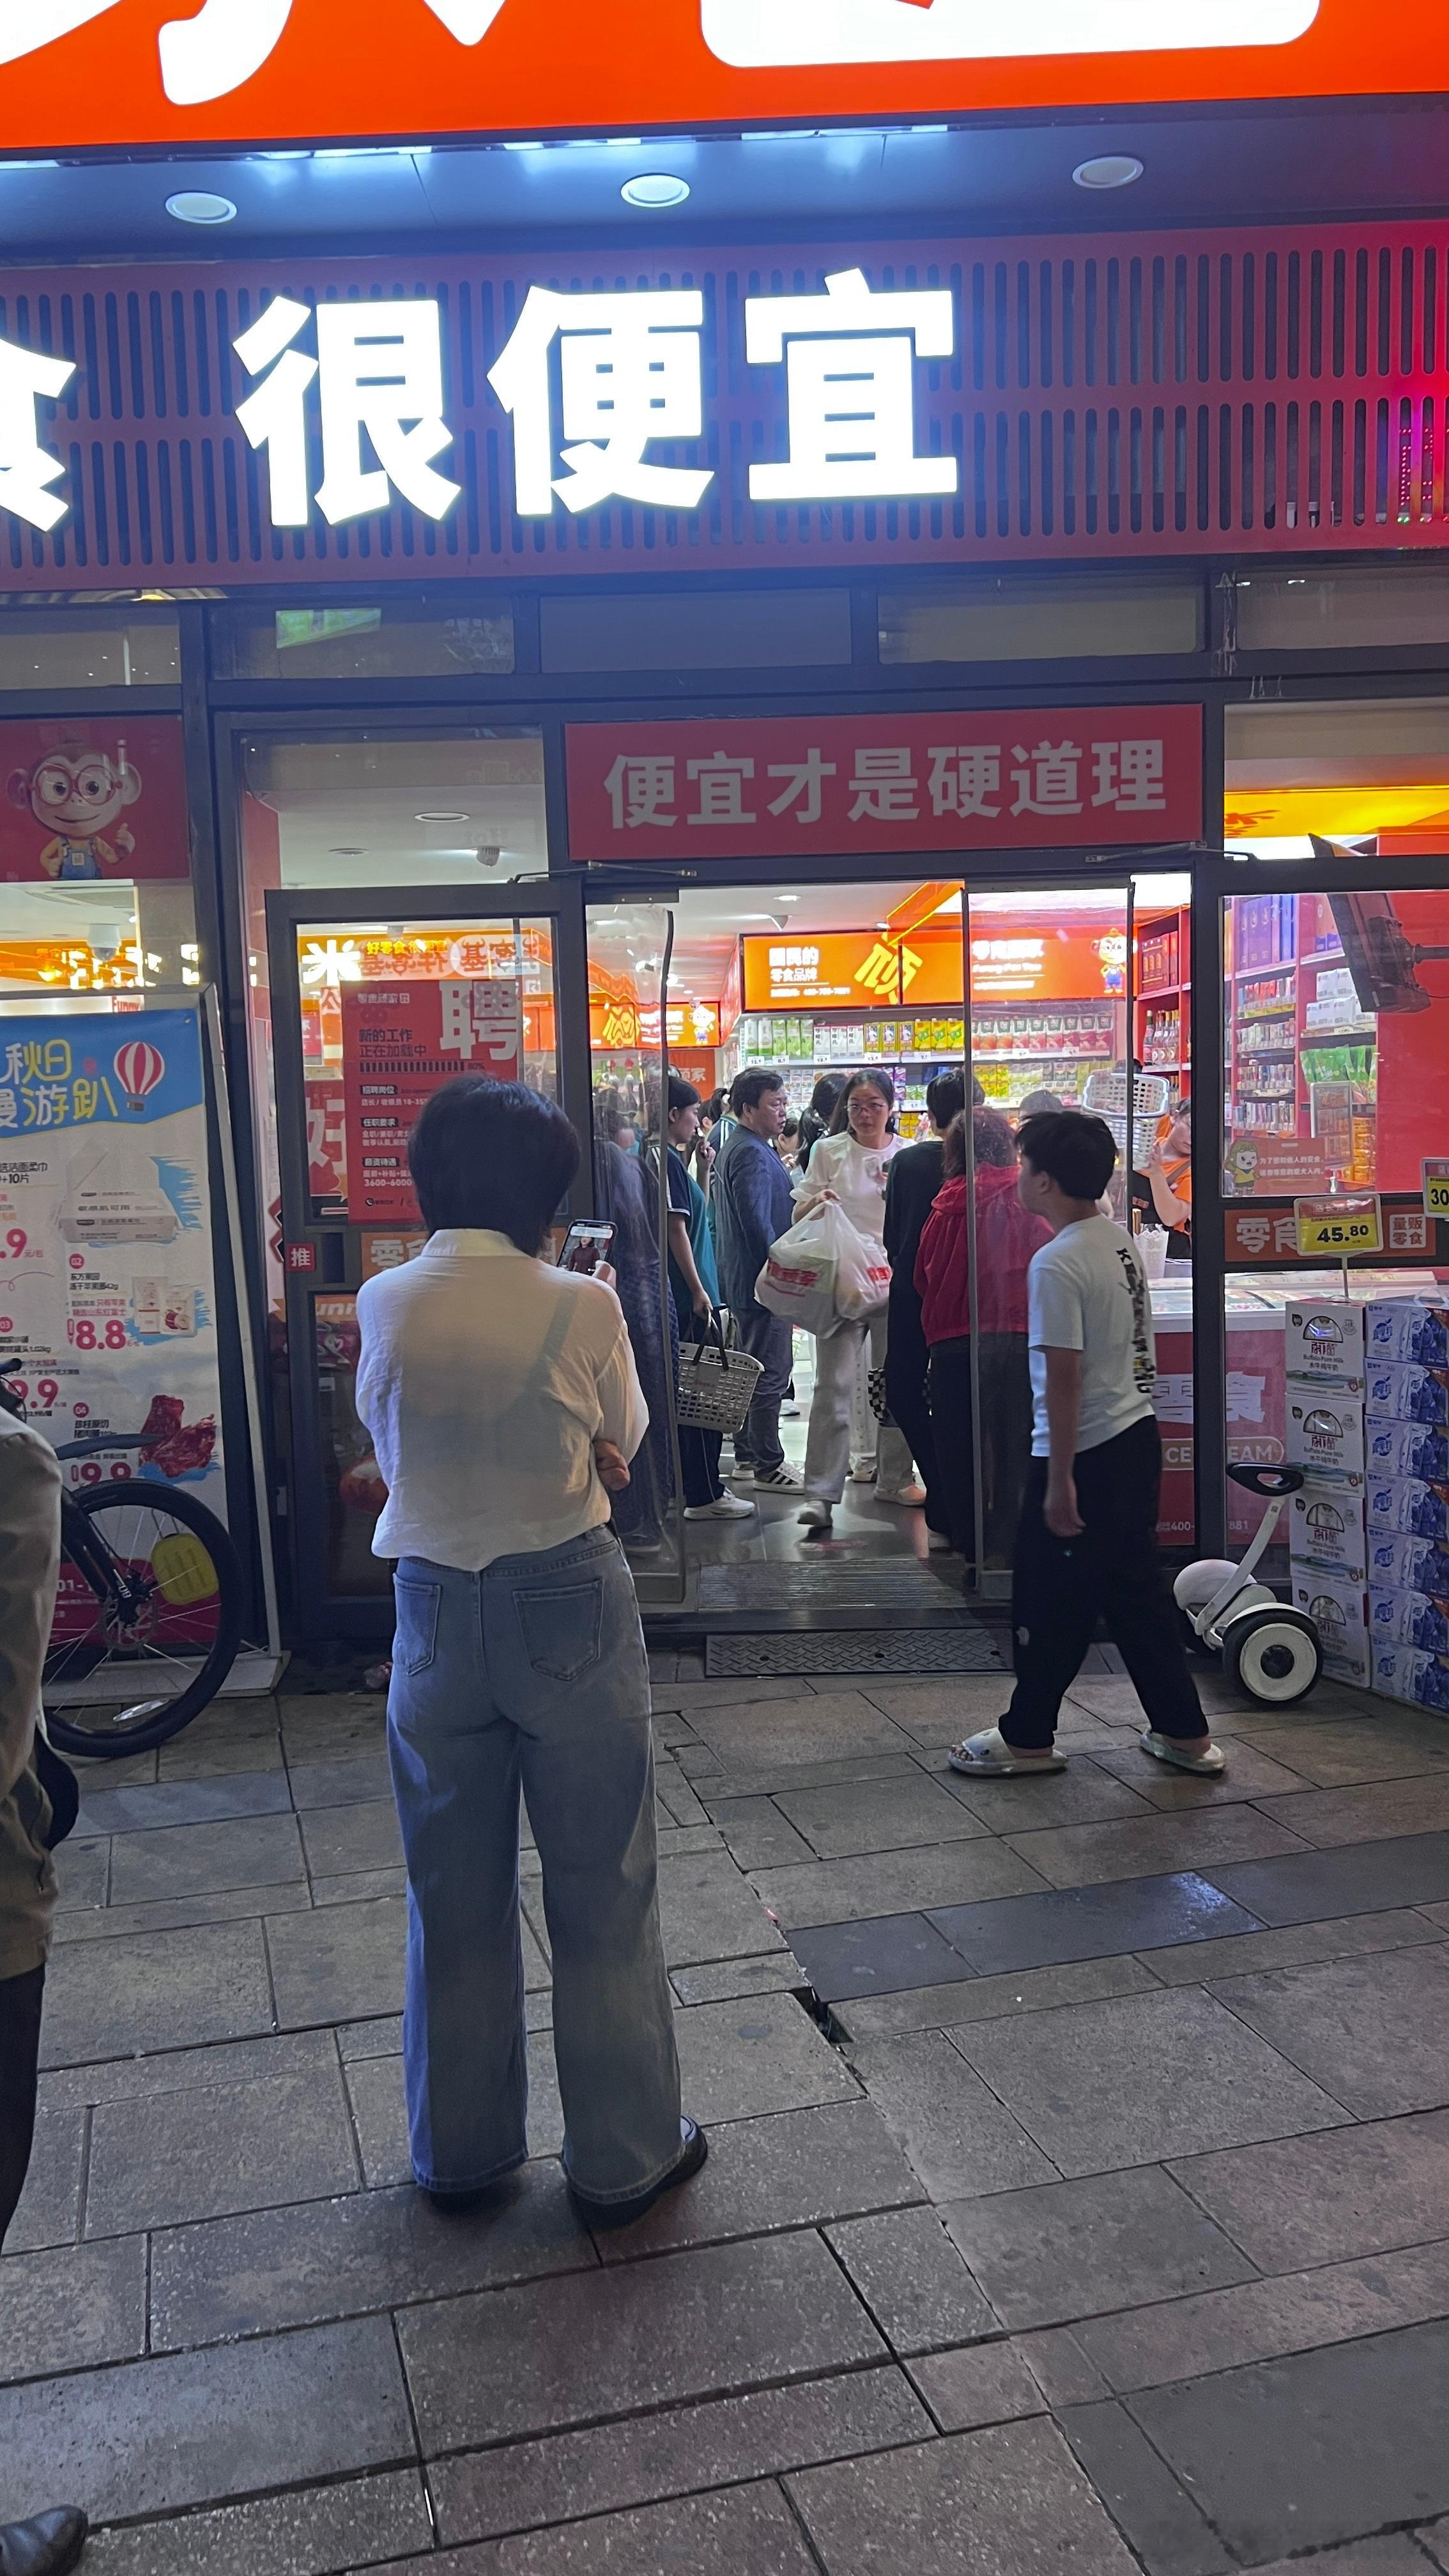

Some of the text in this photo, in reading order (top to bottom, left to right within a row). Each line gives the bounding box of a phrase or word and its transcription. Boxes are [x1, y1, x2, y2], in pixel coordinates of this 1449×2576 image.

[232, 267, 958, 528] 很便宜
[603, 739, 1167, 830] 便宜才是硬道理
[440, 980, 518, 1061] 聘
[359, 1029, 412, 1042] 新的工作
[359, 1045, 426, 1057] 正在加载中
[0, 1039, 72, 1085] 秋日
[1392, 1216, 1423, 1230] 量贩
[1317, 1225, 1368, 1243] 45.80
[1392, 1231, 1423, 1246] 零食
[291, 1247, 311, 1267] 推
[76, 1319, 126, 1350] 8.8
